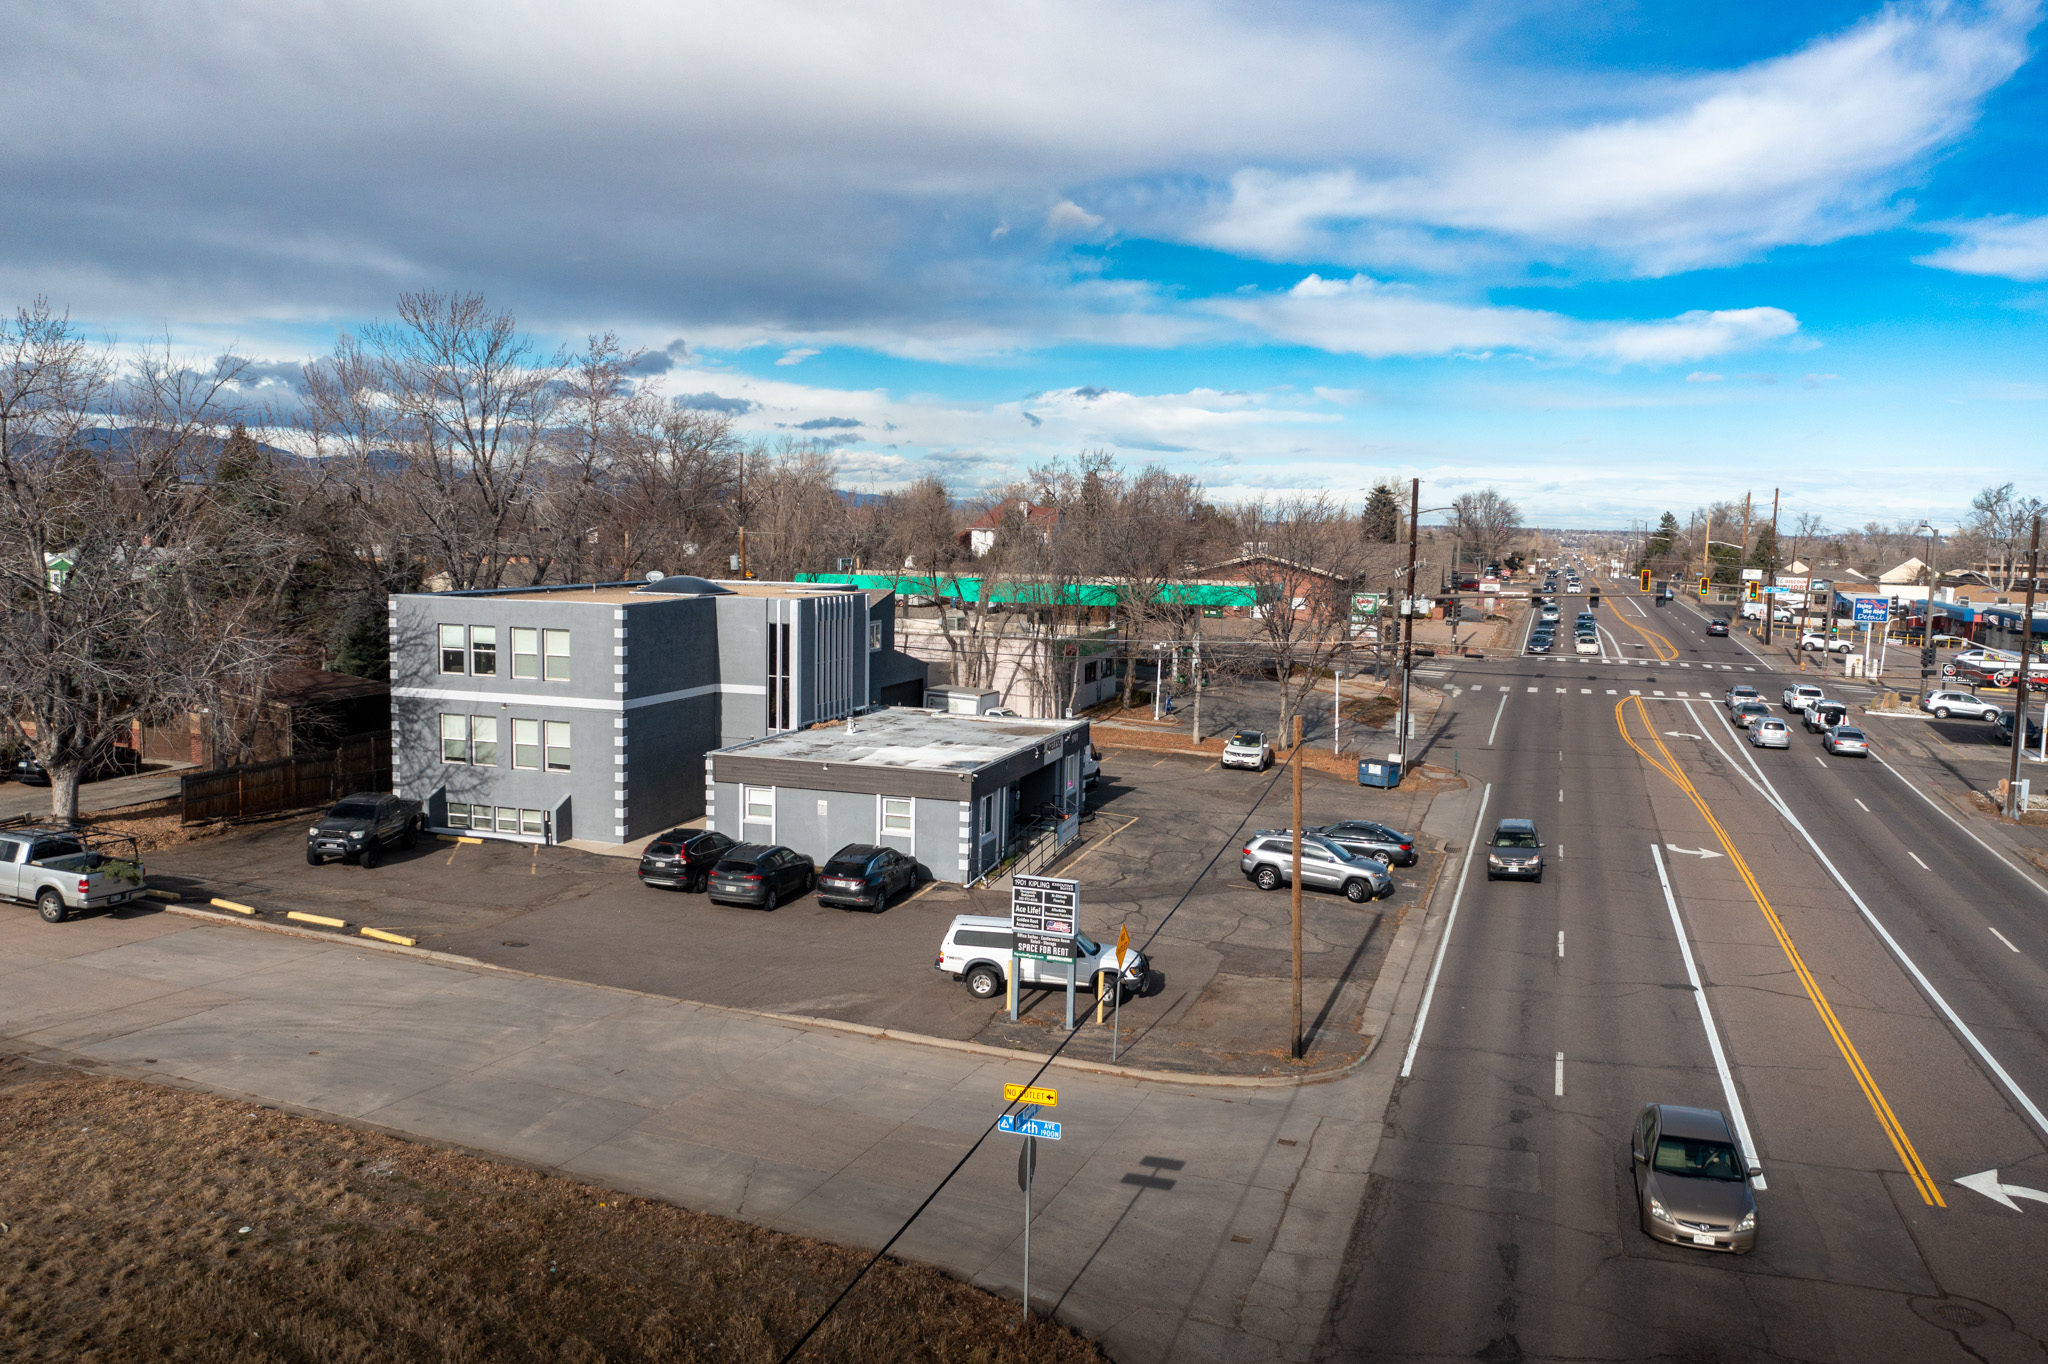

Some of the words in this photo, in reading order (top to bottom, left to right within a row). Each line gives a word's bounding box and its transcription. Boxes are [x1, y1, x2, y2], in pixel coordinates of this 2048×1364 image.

[1028, 880, 1050, 888] KIPLING
[1015, 905, 1026, 913] Ace
[1027, 906, 1041, 914] Life!
[1018, 943, 1038, 953] SPACE
[1039, 945, 1051, 954] FOR
[1053, 946, 1069, 957] RENT
